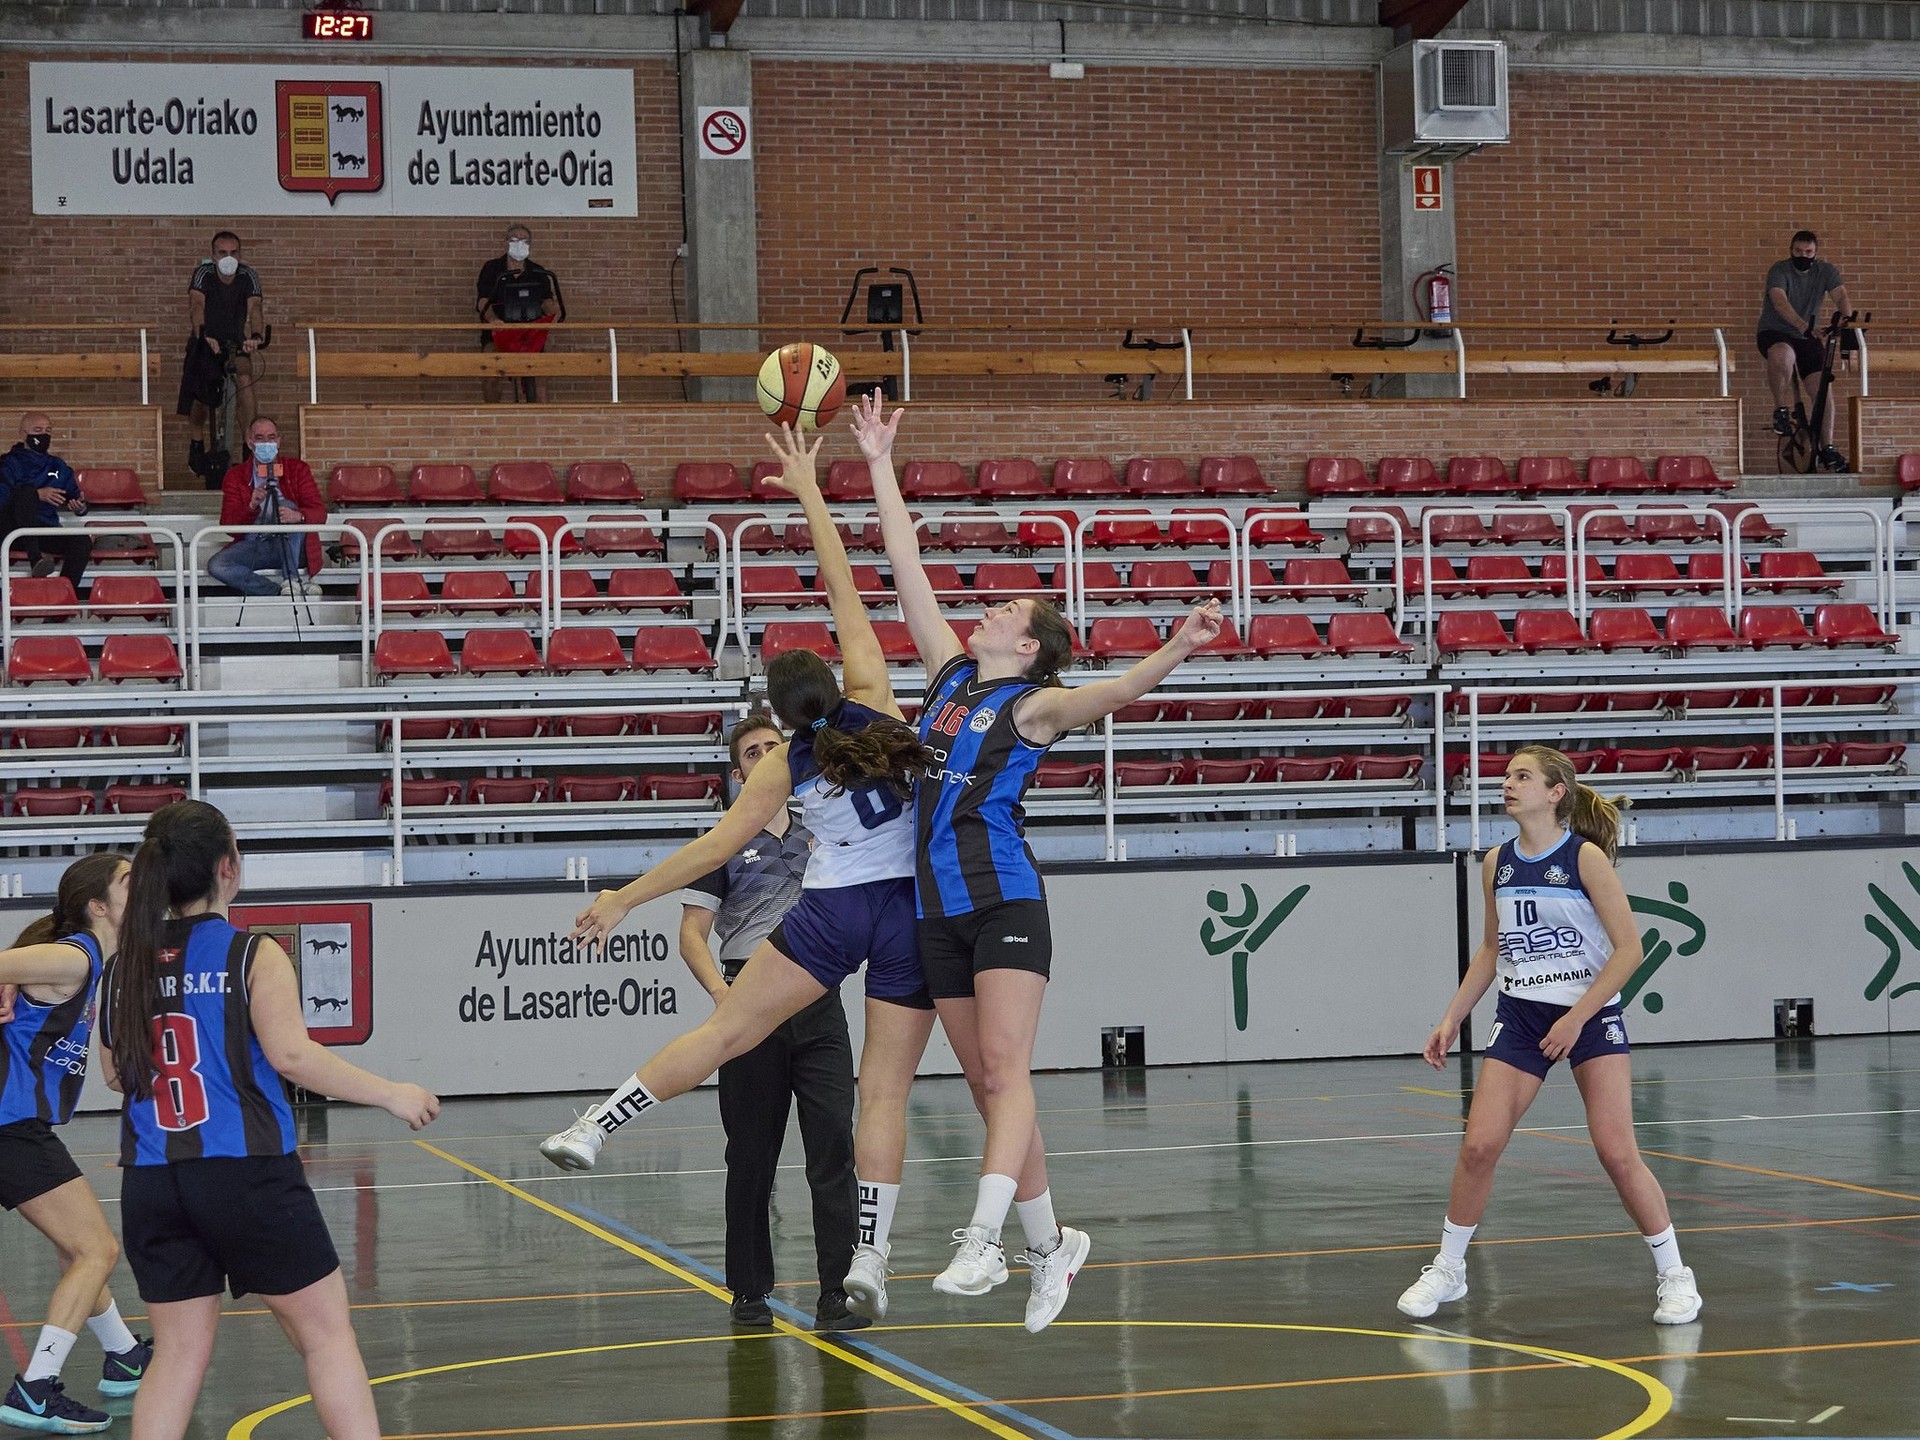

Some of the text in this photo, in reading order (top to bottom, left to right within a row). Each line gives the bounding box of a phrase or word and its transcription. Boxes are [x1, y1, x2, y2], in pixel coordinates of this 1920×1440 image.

[314, 15, 369, 37] 12:27
[45, 97, 258, 135] Lasarte-Oriako
[417, 100, 601, 144] Ayuntamiento
[112, 147, 194, 184] Udala
[407, 149, 613, 187] de Lasarte-Oria
[931, 701, 970, 736] 16
[1514, 900, 1539, 926] 10
[475, 929, 668, 979] Ayuntamiento
[183, 971, 232, 994] S.K.T.
[1514, 968, 1592, 987] PLAGAMANIA
[459, 978, 678, 1022] de Lasarte-Oria
[151, 1012, 210, 1131] 8
